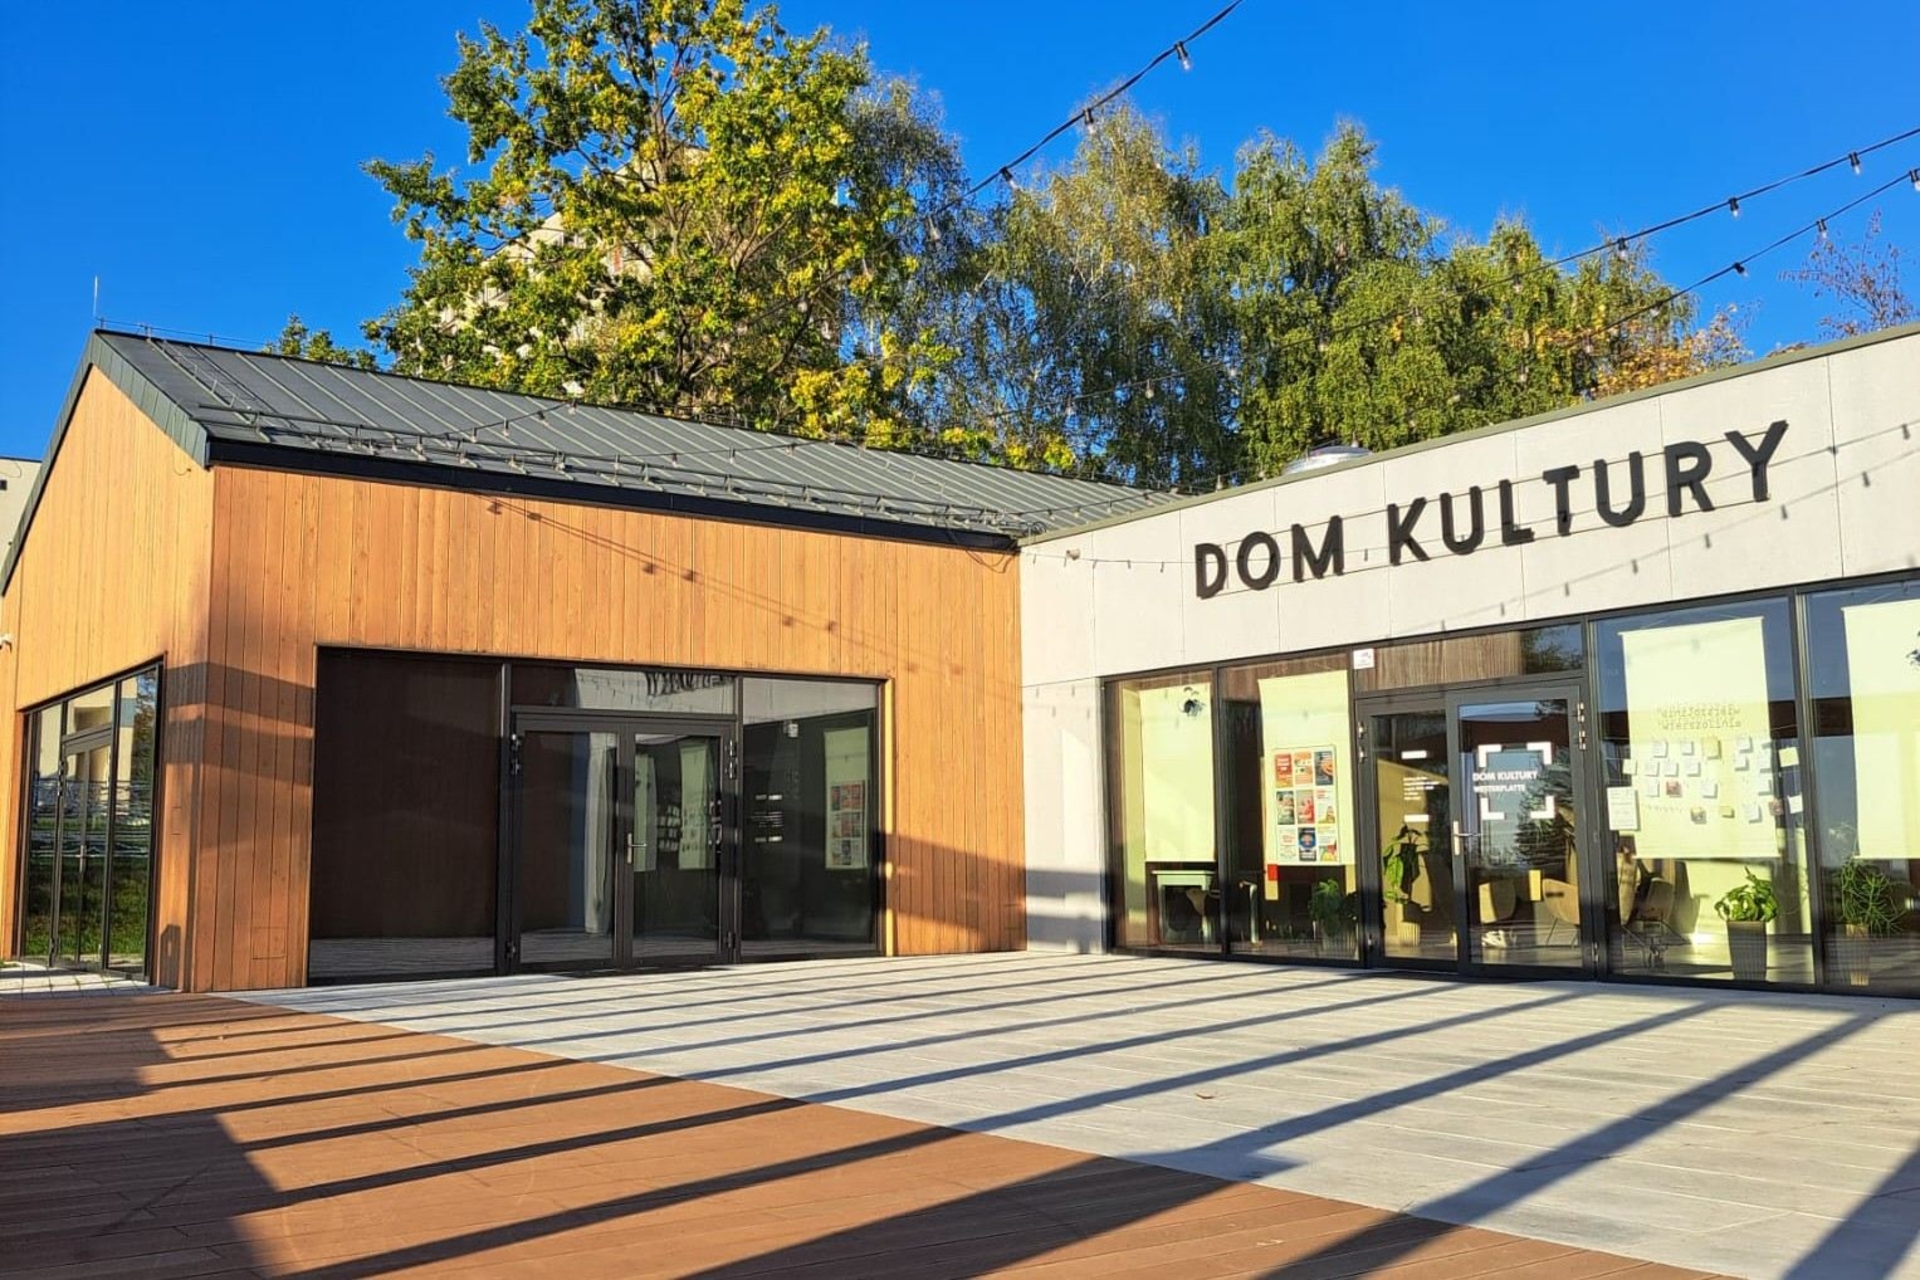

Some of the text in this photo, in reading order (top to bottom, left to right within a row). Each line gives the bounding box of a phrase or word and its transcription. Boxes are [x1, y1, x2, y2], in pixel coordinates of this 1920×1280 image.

[1195, 420, 1788, 599] DOM KULTURY
[1472, 770, 1538, 781] DOM KULTURY
